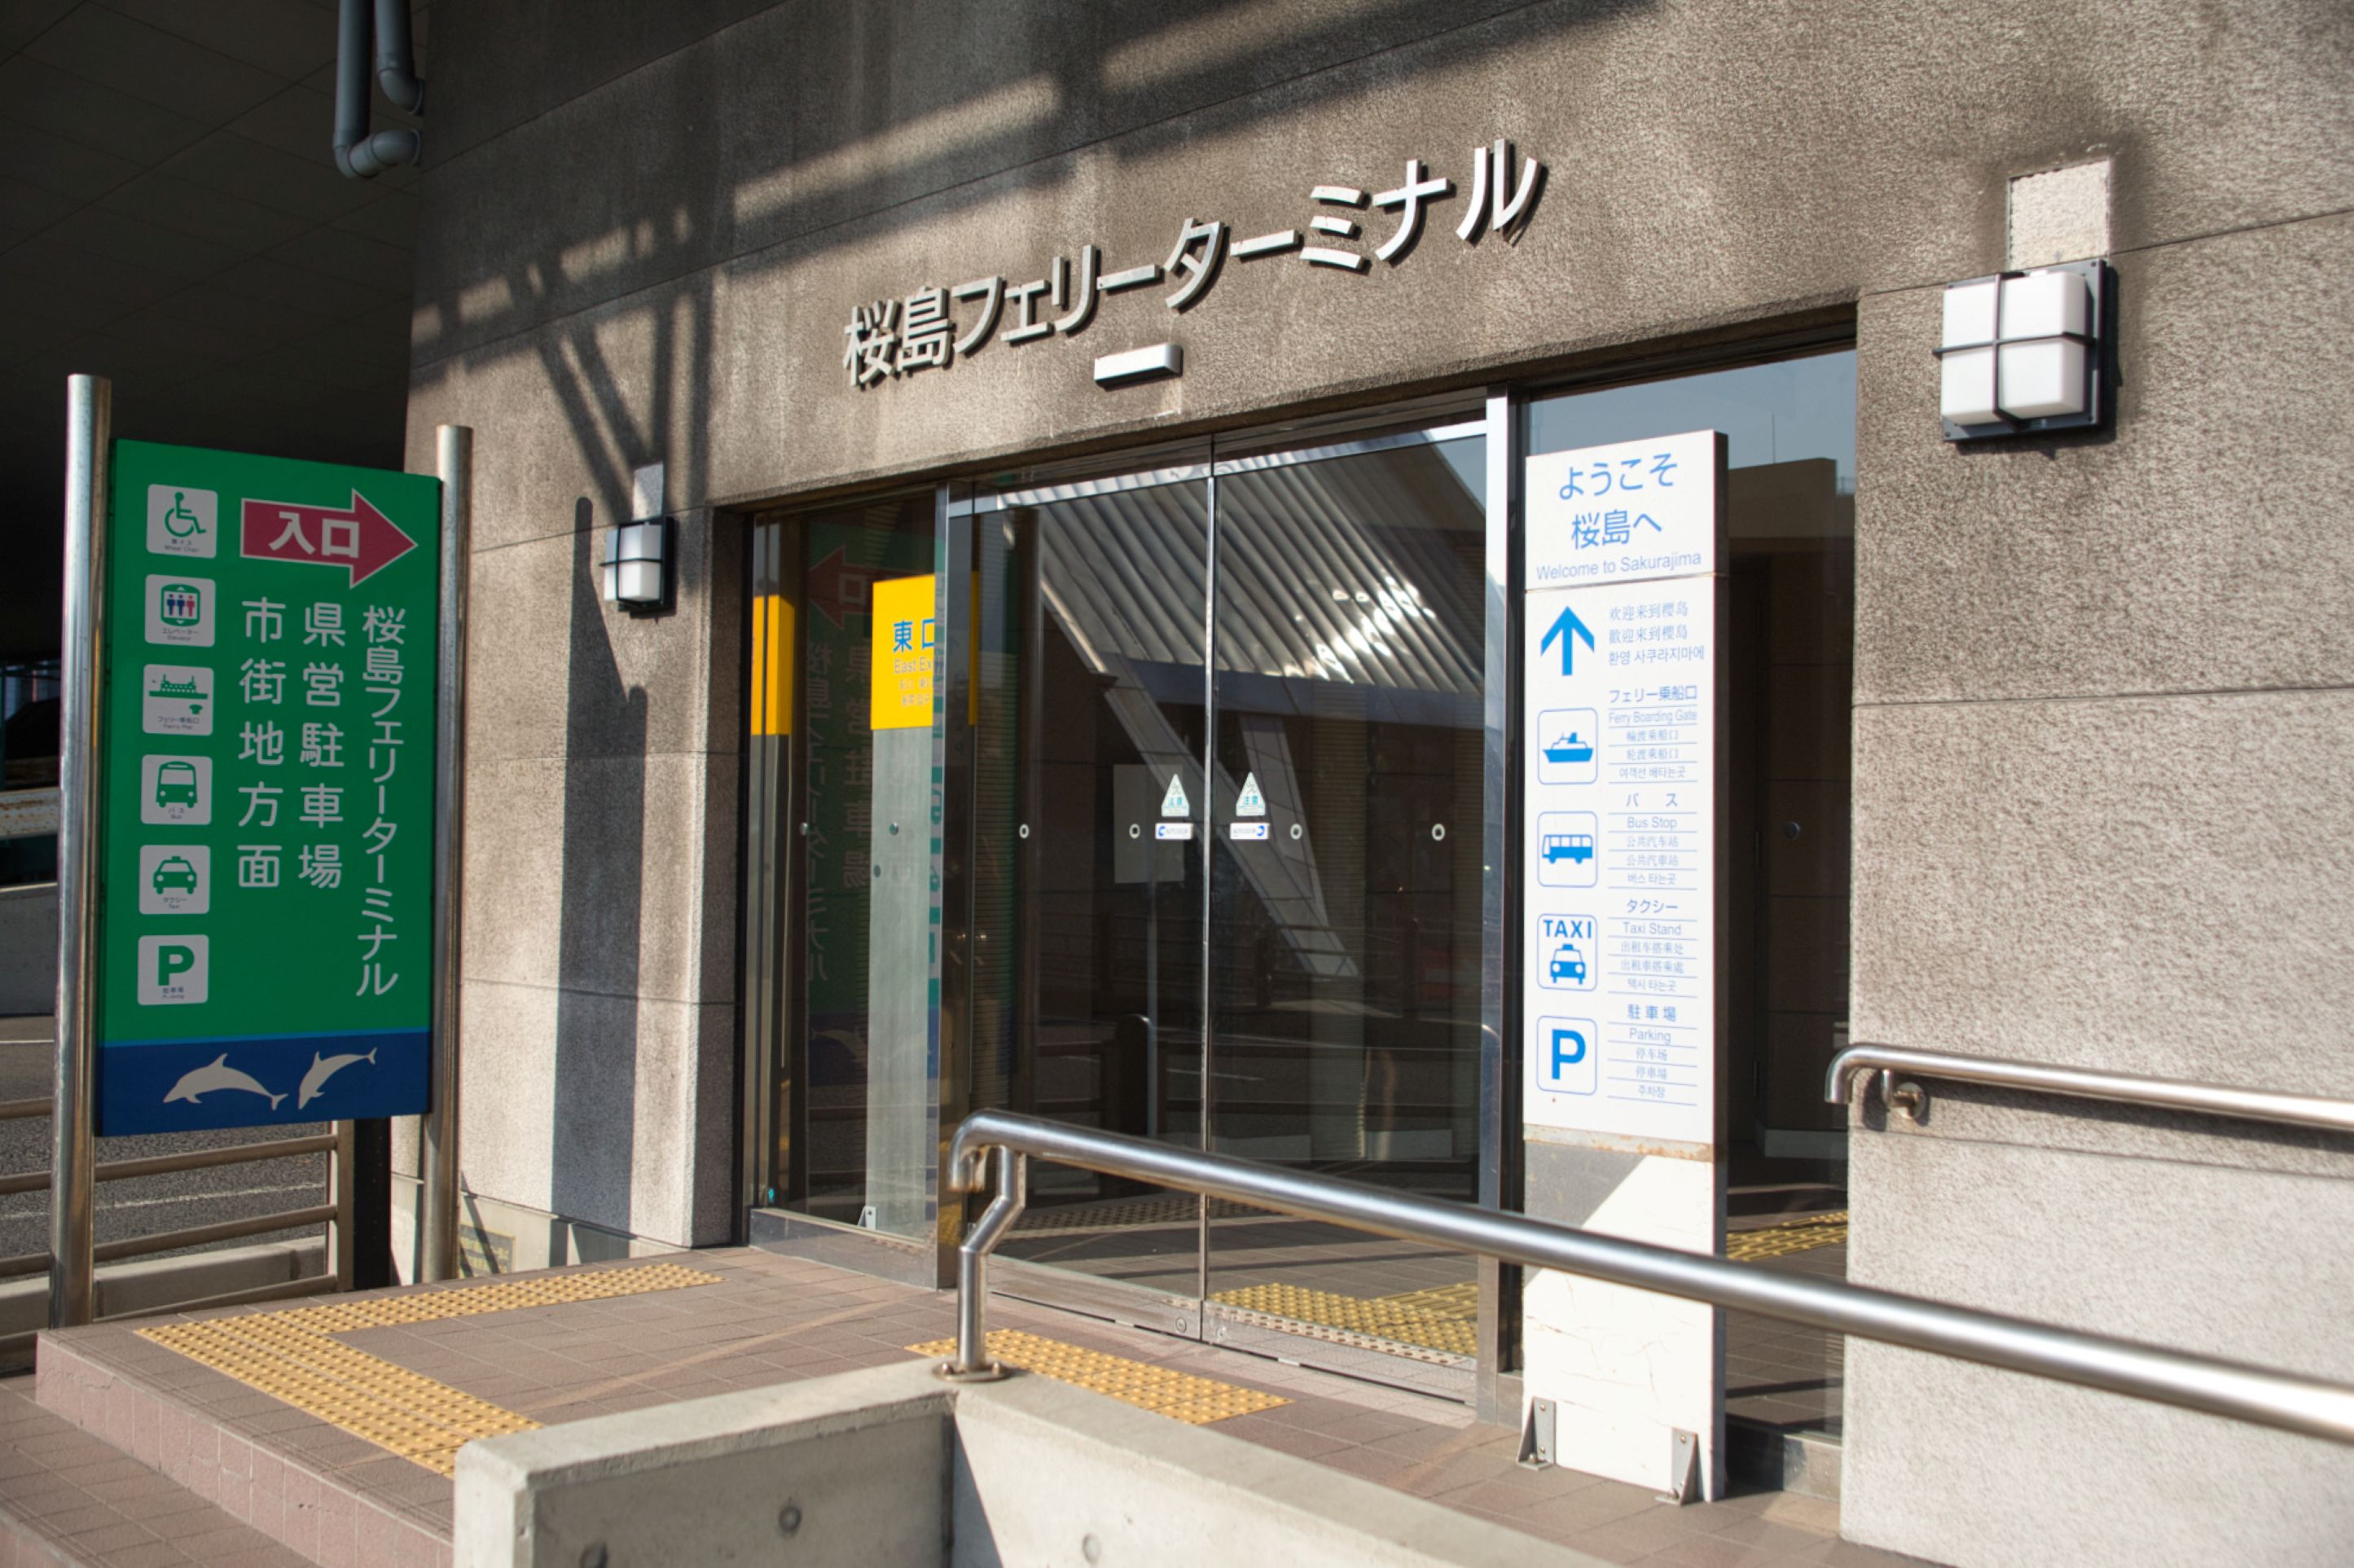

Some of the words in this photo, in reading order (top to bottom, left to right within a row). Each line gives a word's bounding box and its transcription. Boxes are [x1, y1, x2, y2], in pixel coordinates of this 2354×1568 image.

[843, 138, 1540, 387] 桜島フェリーターミナル
[1559, 453, 1677, 500] ようこそ
[269, 512, 360, 559] 入口
[1571, 509, 1662, 551] 桜島へ
[1536, 561, 1599, 581] Welcome
[1603, 560, 1616, 573] to
[1620, 552, 1702, 573] Sakurajima
[1609, 649, 1632, 666] 환영
[1635, 644, 1705, 665] 사쿠라지마에
[894, 659, 916, 674] East
[1609, 684, 1697, 704] フェリー乗船口
[1609, 712, 1631, 727] Ferry
[1633, 709, 1673, 726] Boarding
[1675, 709, 1698, 721] Gate
[237, 597, 286, 888] 市街地方面
[298, 602, 345, 889] 県営駐車場
[356, 604, 406, 997] 桜島フェリーターミナル
[1627, 792, 1678, 807] バス
[1627, 815, 1648, 828] Bus
[1652, 815, 1677, 832] Stop
[1627, 872, 1646, 885] 버스
[1627, 898, 1678, 913] タクシー
[1543, 920, 1592, 939] TAXI
[1623, 921, 1645, 934] Taxi
[1649, 922, 1682, 936] Stand
[158, 946, 195, 986] P
[1627, 977, 1645, 990] 택시
[1627, 1004, 1676, 1022] 駐車場
[1629, 1027, 1671, 1045] Parking
[1551, 1028, 1587, 1080] P
